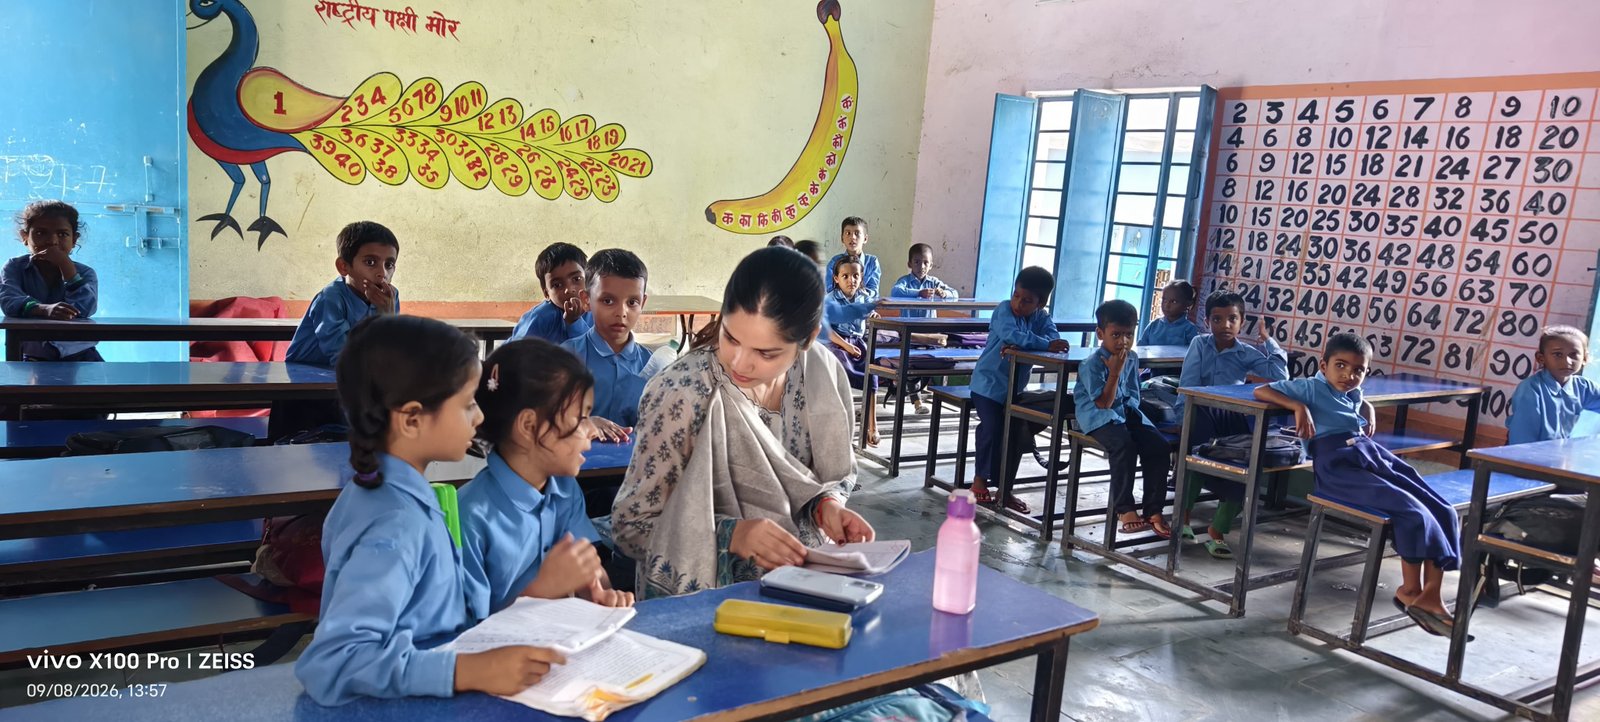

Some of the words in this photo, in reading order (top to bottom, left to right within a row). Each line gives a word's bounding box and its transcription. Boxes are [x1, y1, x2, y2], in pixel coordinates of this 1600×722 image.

[382, 6, 419, 35] पक्षी
[425, 11, 460, 42] मोर
[274, 91, 286, 115] 1
[341, 105, 353, 123] 2
[354, 94, 369, 116] 3
[371, 86, 387, 106] 4
[388, 107, 402, 124] 5
[402, 98, 413, 116] 6
[412, 89, 424, 112] 7
[424, 83, 436, 104] 8
[440, 105, 452, 122] 9
[455, 95, 469, 117] 10
[470, 88, 482, 107] 11
[1232, 102, 1248, 124] 2
[1266, 102, 1285, 124] 3
[1298, 100, 1319, 124] 4
[1335, 100, 1354, 123] 5
[1372, 100, 1389, 120] 6
[1413, 97, 1435, 120] 7
[1455, 96, 1472, 118] 8
[1500, 96, 1522, 118] 9
[1550, 96, 1582, 119] 10
[478, 113, 494, 132] 12
[500, 105, 517, 126] 13
[520, 123, 536, 141] 14
[540, 116, 554, 134] 15
[560, 125, 572, 142] 16
[576, 118, 589, 136] 17
[338, 128, 368, 148] 36
[370, 138, 396, 158] 37
[392, 128, 418, 147] 33
[416, 139, 440, 163] 34
[434, 128, 458, 146] 30
[454, 140, 476, 161] 31
[587, 136, 600, 150] 18
[605, 129, 618, 146] 19
[1227, 127, 1244, 148] 4
[1263, 128, 1278, 147] 6
[1296, 126, 1312, 147] 8
[1328, 127, 1352, 148] 10
[1366, 126, 1392, 150] 12
[1403, 126, 1429, 149] 14
[1446, 126, 1470, 150] 16
[1495, 125, 1522, 149] 18
[1538, 125, 1579, 150] 20
[310, 134, 337, 155] 39
[334, 152, 362, 177] 40
[372, 159, 398, 179] 38
[484, 143, 509, 165] 28
[502, 164, 523, 188] 29
[516, 144, 541, 164] 26
[608, 152, 629, 169] 20
[628, 158, 646, 175] 21
[1226, 152, 1238, 172] 6
[1259, 152, 1276, 172] 9
[1292, 152, 1314, 174] 12
[1326, 153, 1347, 176] 15
[1360, 153, 1384, 176] 18
[1395, 154, 1423, 178] 21
[1436, 155, 1470, 180] 24
[1483, 155, 1521, 180] 27
[1533, 157, 1573, 184] 30
[418, 163, 440, 183] 35
[558, 159, 579, 179] 24
[570, 178, 589, 196] 25
[580, 158, 603, 178] 22
[596, 174, 616, 196] 23
[1222, 178, 1236, 198] 8
[1255, 180, 1274, 201] 12
[1288, 180, 1308, 202] 16
[1318, 184, 1346, 205] 20
[1352, 183, 1381, 207] 24
[1389, 186, 1420, 208] 28
[1434, 186, 1464, 210] 32
[1480, 188, 1510, 214] 36
[1523, 190, 1566, 216] 40
[722, 212, 734, 224] क
[740, 214, 752, 227] का
[772, 208, 782, 223] की
[785, 204, 796, 220] कु
[1220, 204, 1238, 224] 10
[1252, 206, 1272, 226] 15
[1280, 207, 1308, 228] 20
[1312, 209, 1340, 232] 25
[1348, 210, 1380, 232] 30
[1384, 214, 1418, 236] 35
[1424, 215, 1462, 239] 40
[1470, 218, 1509, 242] 45
[1518, 220, 1558, 246] 50
[1216, 228, 1235, 249] 12
[1248, 230, 1268, 251] 18
[1275, 232, 1302, 256] 24
[1308, 236, 1338, 259] 30
[1344, 238, 1371, 262] 36
[1378, 242, 1412, 266] 42
[1416, 243, 1456, 269] 48
[1465, 248, 1500, 275] 54
[1512, 252, 1552, 277] 60
[1212, 253, 1232, 276] 14
[1241, 256, 1262, 279] 21
[1270, 259, 1298, 281] 28
[1303, 262, 1330, 286] 35
[1336, 266, 1368, 289] 42
[1373, 270, 1406, 294] 49
[1412, 272, 1448, 298] 56
[1459, 278, 1495, 304] 63
[1510, 282, 1548, 308] 70
[1238, 283, 1261, 308] 24
[1266, 286, 1295, 312] 32
[1298, 289, 1328, 316] 40
[1331, 294, 1361, 319] 48
[1368, 297, 1397, 324] 56
[1407, 302, 1441, 330] 64
[1454, 307, 1484, 334] 72
[1498, 310, 1538, 336] 80
[1295, 320, 1322, 348] 45
[1402, 335, 1436, 365] 72
[1444, 342, 1474, 370] 81
[1490, 349, 1532, 380] 90
